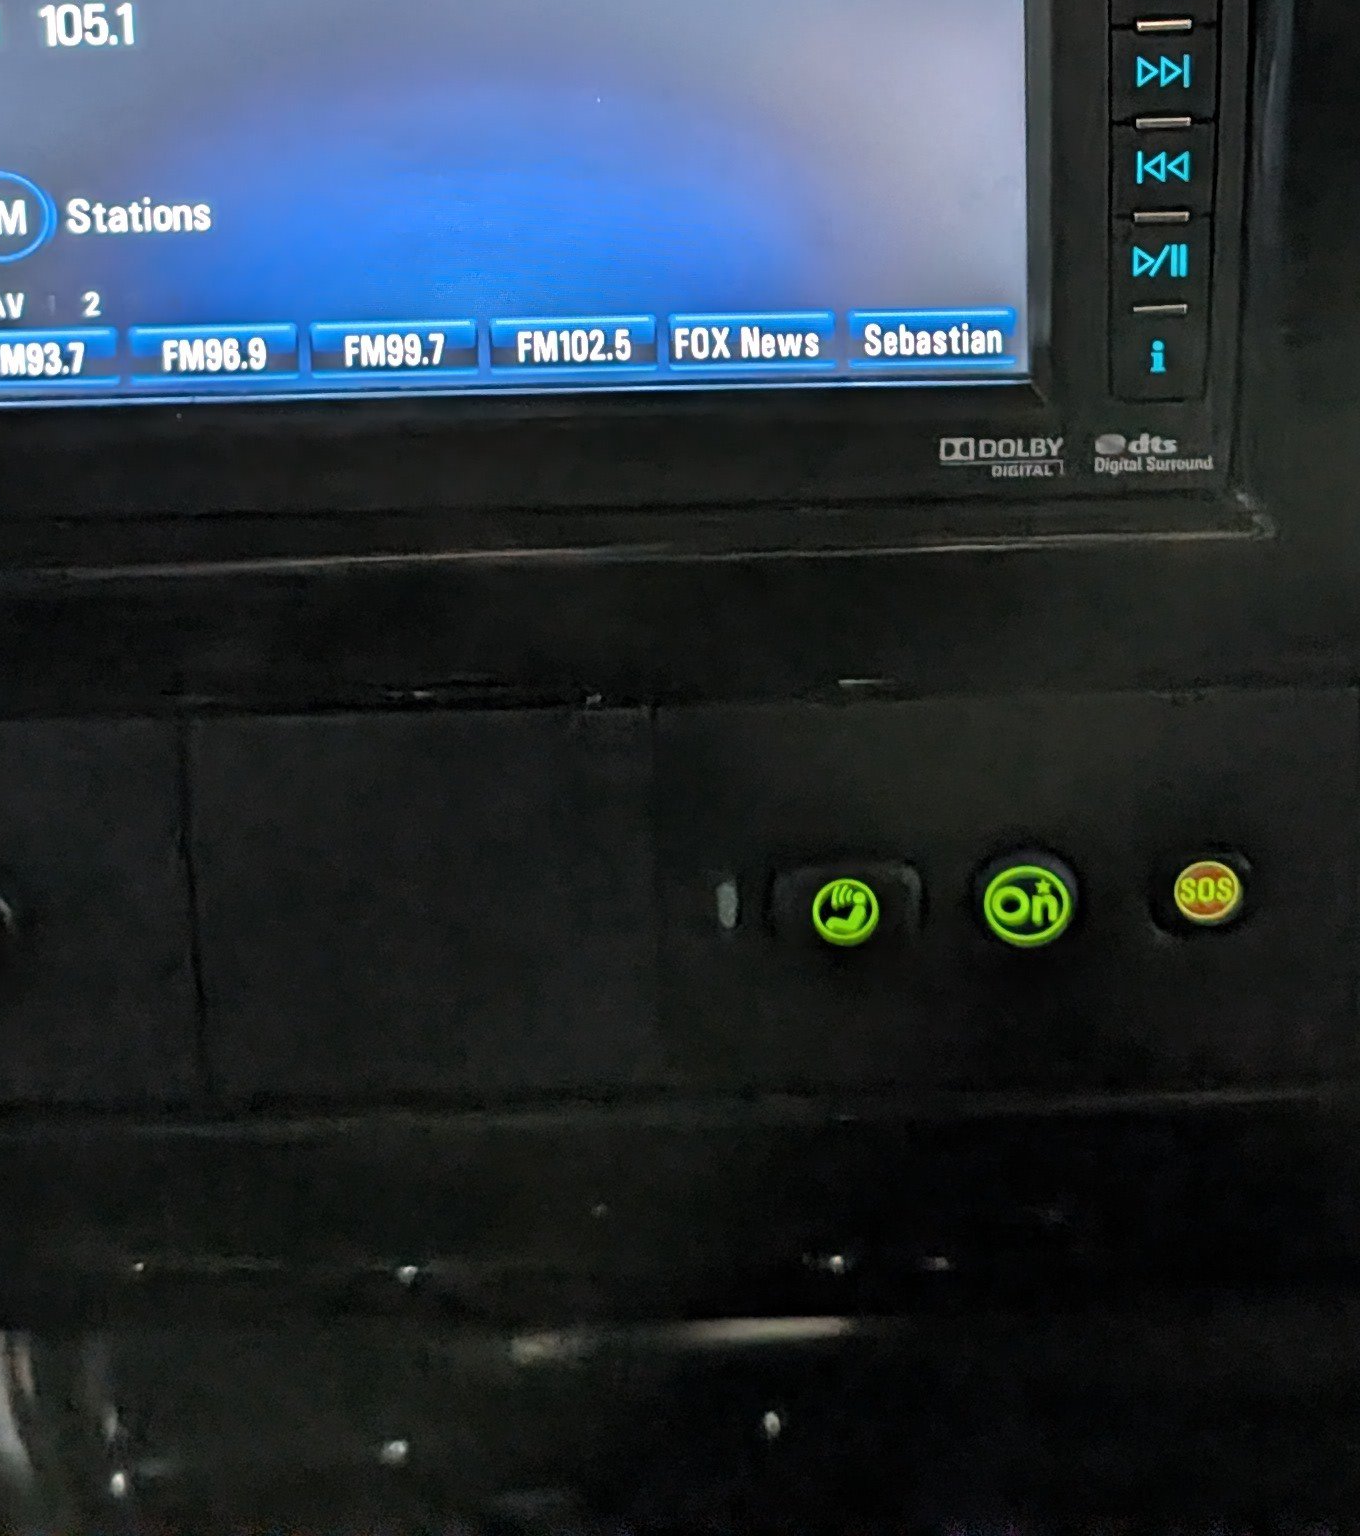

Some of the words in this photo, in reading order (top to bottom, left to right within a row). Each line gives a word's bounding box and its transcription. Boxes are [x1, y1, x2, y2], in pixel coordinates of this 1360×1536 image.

[39, 3, 135, 46] 105.1
[65, 197, 211, 235] Stations
[81, 291, 101, 317] 2
[162, 337, 267, 371] FM96.9
[343, 332, 445, 367] FM99.7
[517, 329, 632, 362] FM102.5
[674, 327, 730, 359] FOX
[740, 325, 820, 358] News
[864, 323, 1003, 357] Sebastian
[978, 437, 1064, 458] DOLBY
[1126, 433, 1177, 454] dts
[991, 464, 1054, 477] DIGITAL
[1094, 455, 1141, 475] Digital
[1145, 454, 1213, 472] Surround
[1179, 877, 1234, 902] SOS
